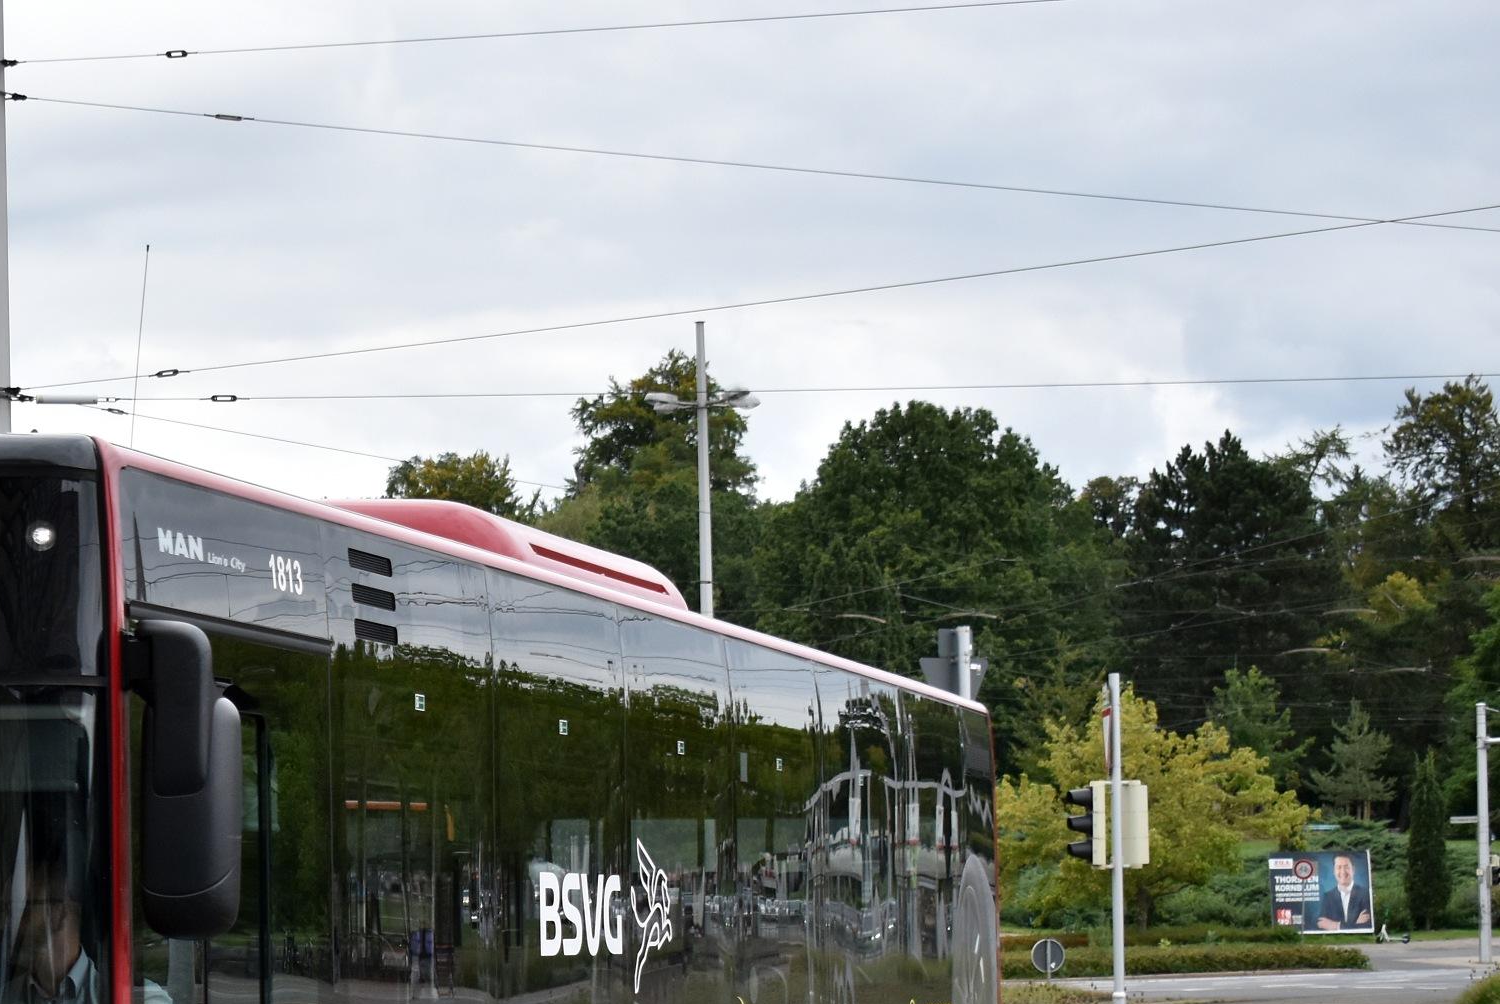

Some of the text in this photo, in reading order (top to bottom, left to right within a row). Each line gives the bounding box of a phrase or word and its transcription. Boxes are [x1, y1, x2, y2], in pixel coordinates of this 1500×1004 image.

[157, 527, 204, 561] MAN
[230, 557, 246, 572] City
[269, 554, 303, 595] 1813
[540, 872, 623, 956] BSVG
